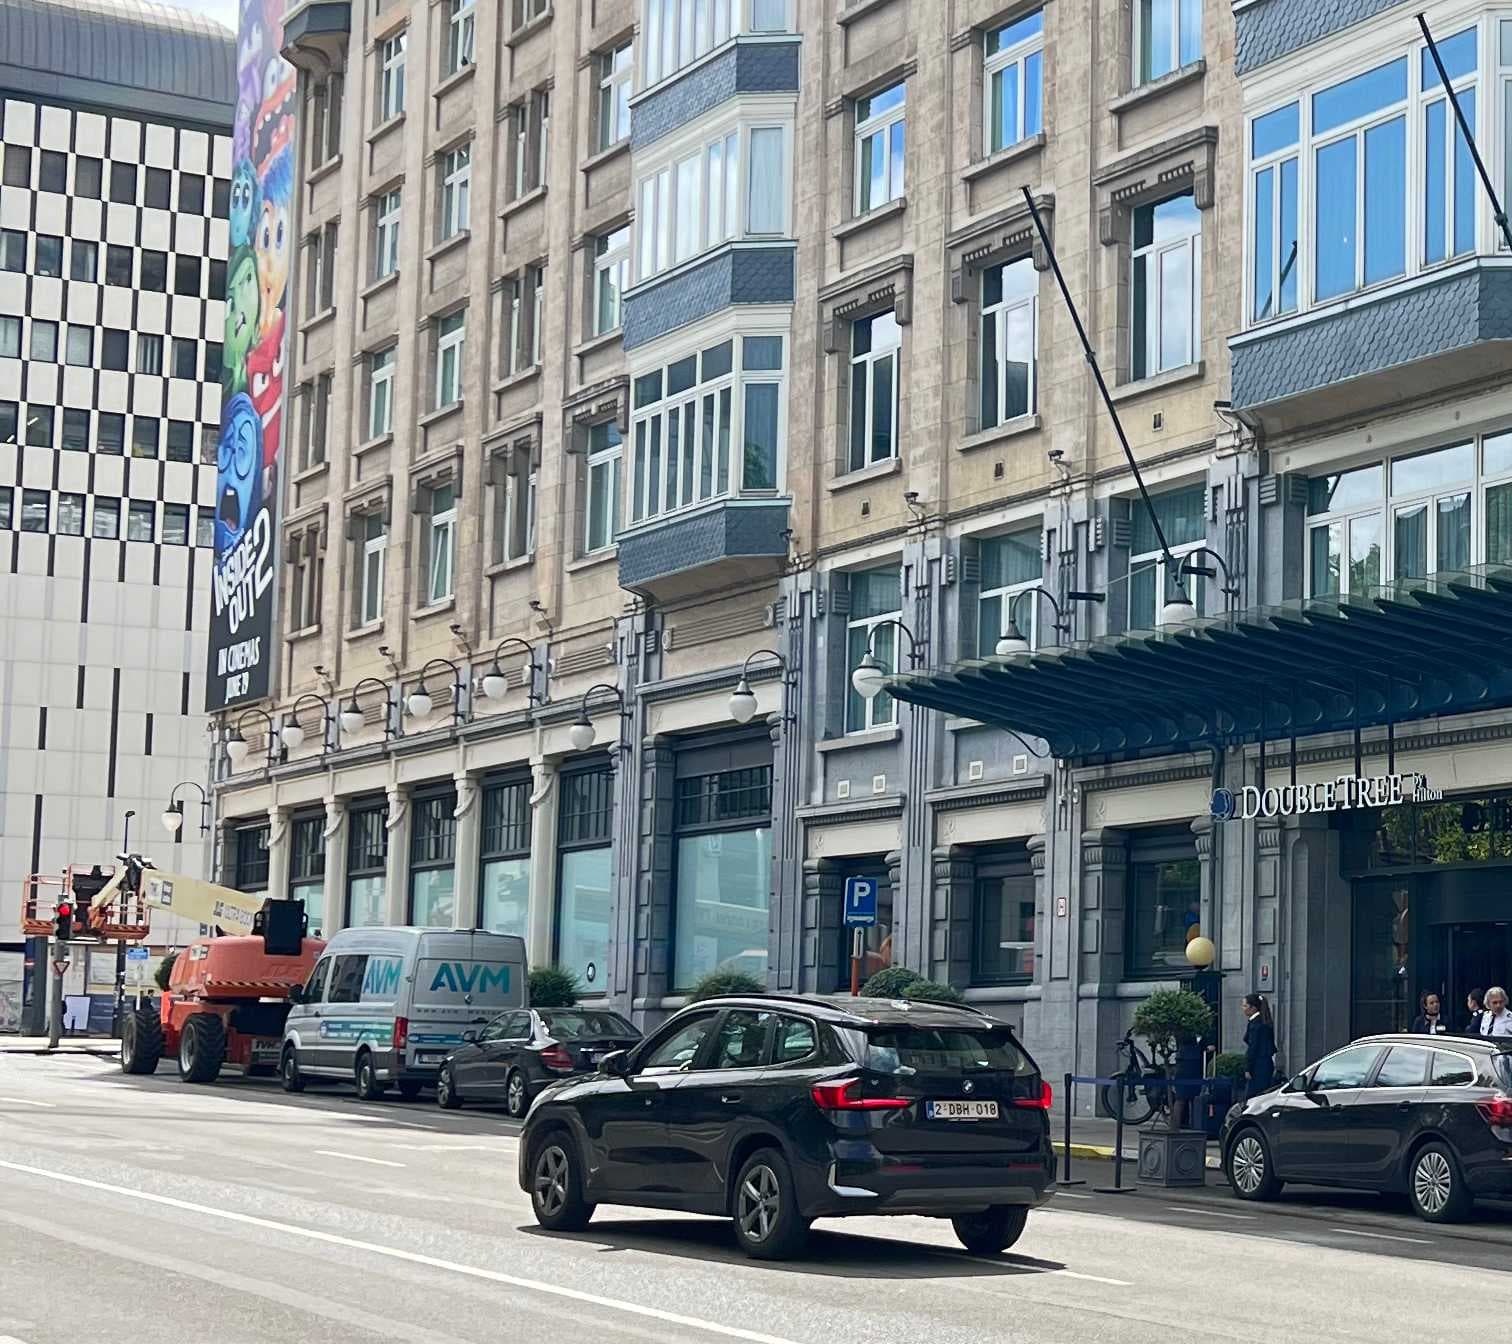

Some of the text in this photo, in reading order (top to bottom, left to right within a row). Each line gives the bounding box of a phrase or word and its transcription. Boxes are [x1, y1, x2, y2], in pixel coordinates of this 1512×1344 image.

[214, 528, 257, 616] INSIDE
[229, 563, 256, 634] OUT
[253, 507, 273, 599] 2
[217, 636, 261, 676] IN CINEMAS
[1412, 787, 1443, 803] Hilton
[1413, 772, 1427, 790] by
[853, 881, 871, 907] P
[363, 959, 403, 994] AVM
[430, 962, 512, 994] AVM
